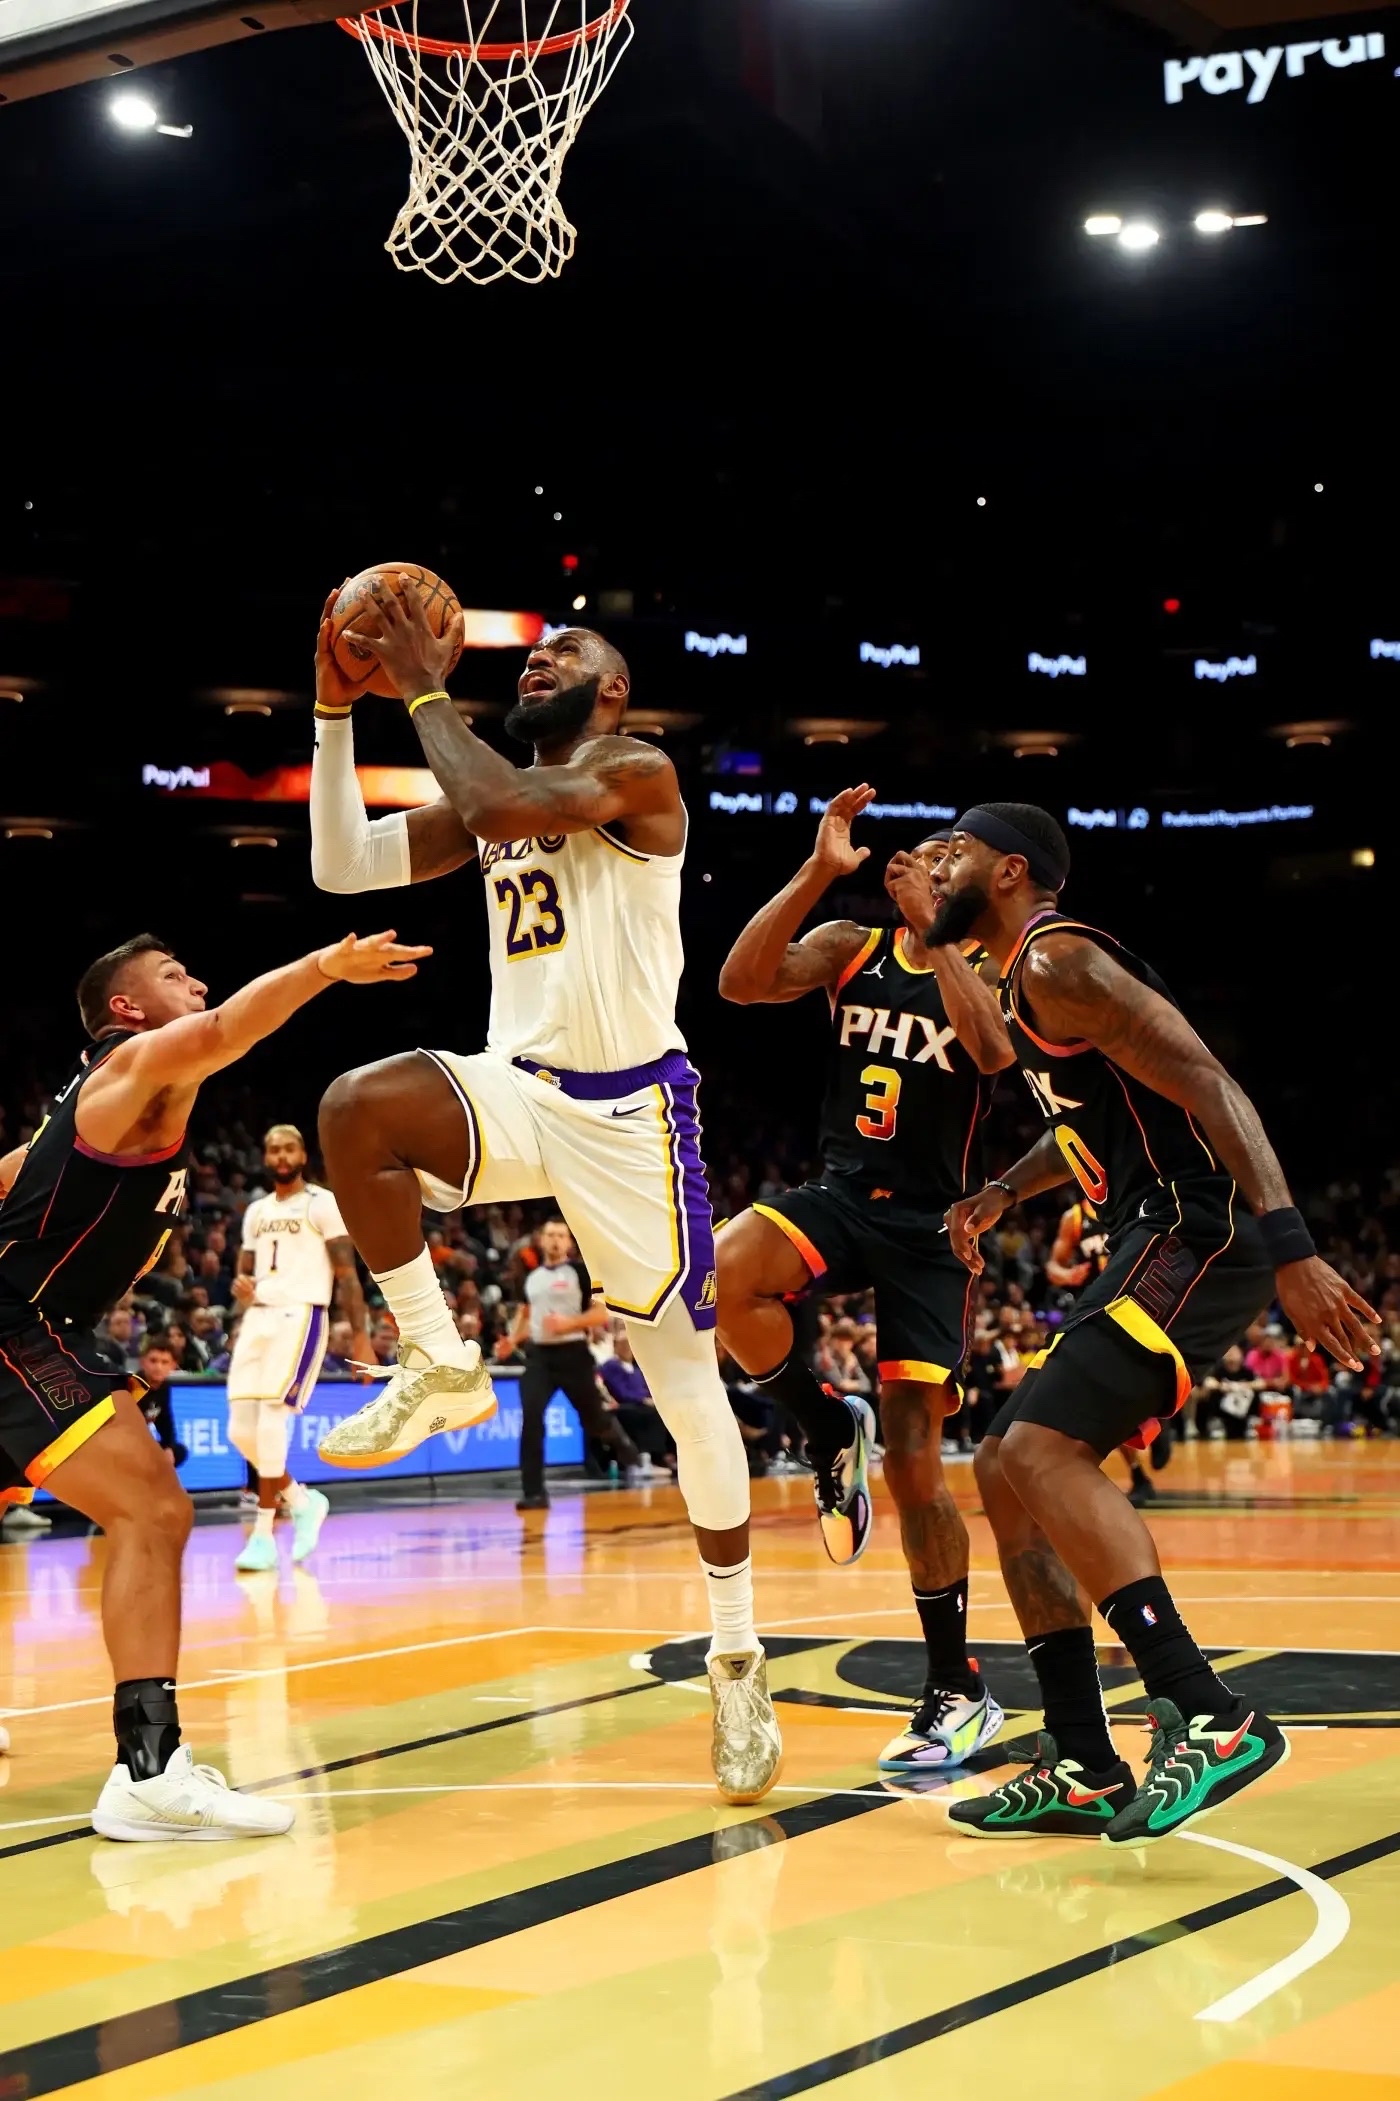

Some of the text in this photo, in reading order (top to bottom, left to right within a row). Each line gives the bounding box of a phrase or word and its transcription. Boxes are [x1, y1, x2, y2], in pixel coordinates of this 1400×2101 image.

[685, 630, 748, 657] PayPal
[859, 641, 920, 668] PayPal
[1028, 652, 1087, 678] PayPal
[1194, 654, 1257, 682] PayPal
[142, 763, 210, 791] PayPal
[709, 791, 763, 814] PayPal
[1067, 807, 1117, 829] PayPal
[492, 866, 568, 963] 23
[838, 1004, 957, 1073] PHX
[855, 1064, 902, 1141] 3
[269, 1240, 279, 1274] 1
